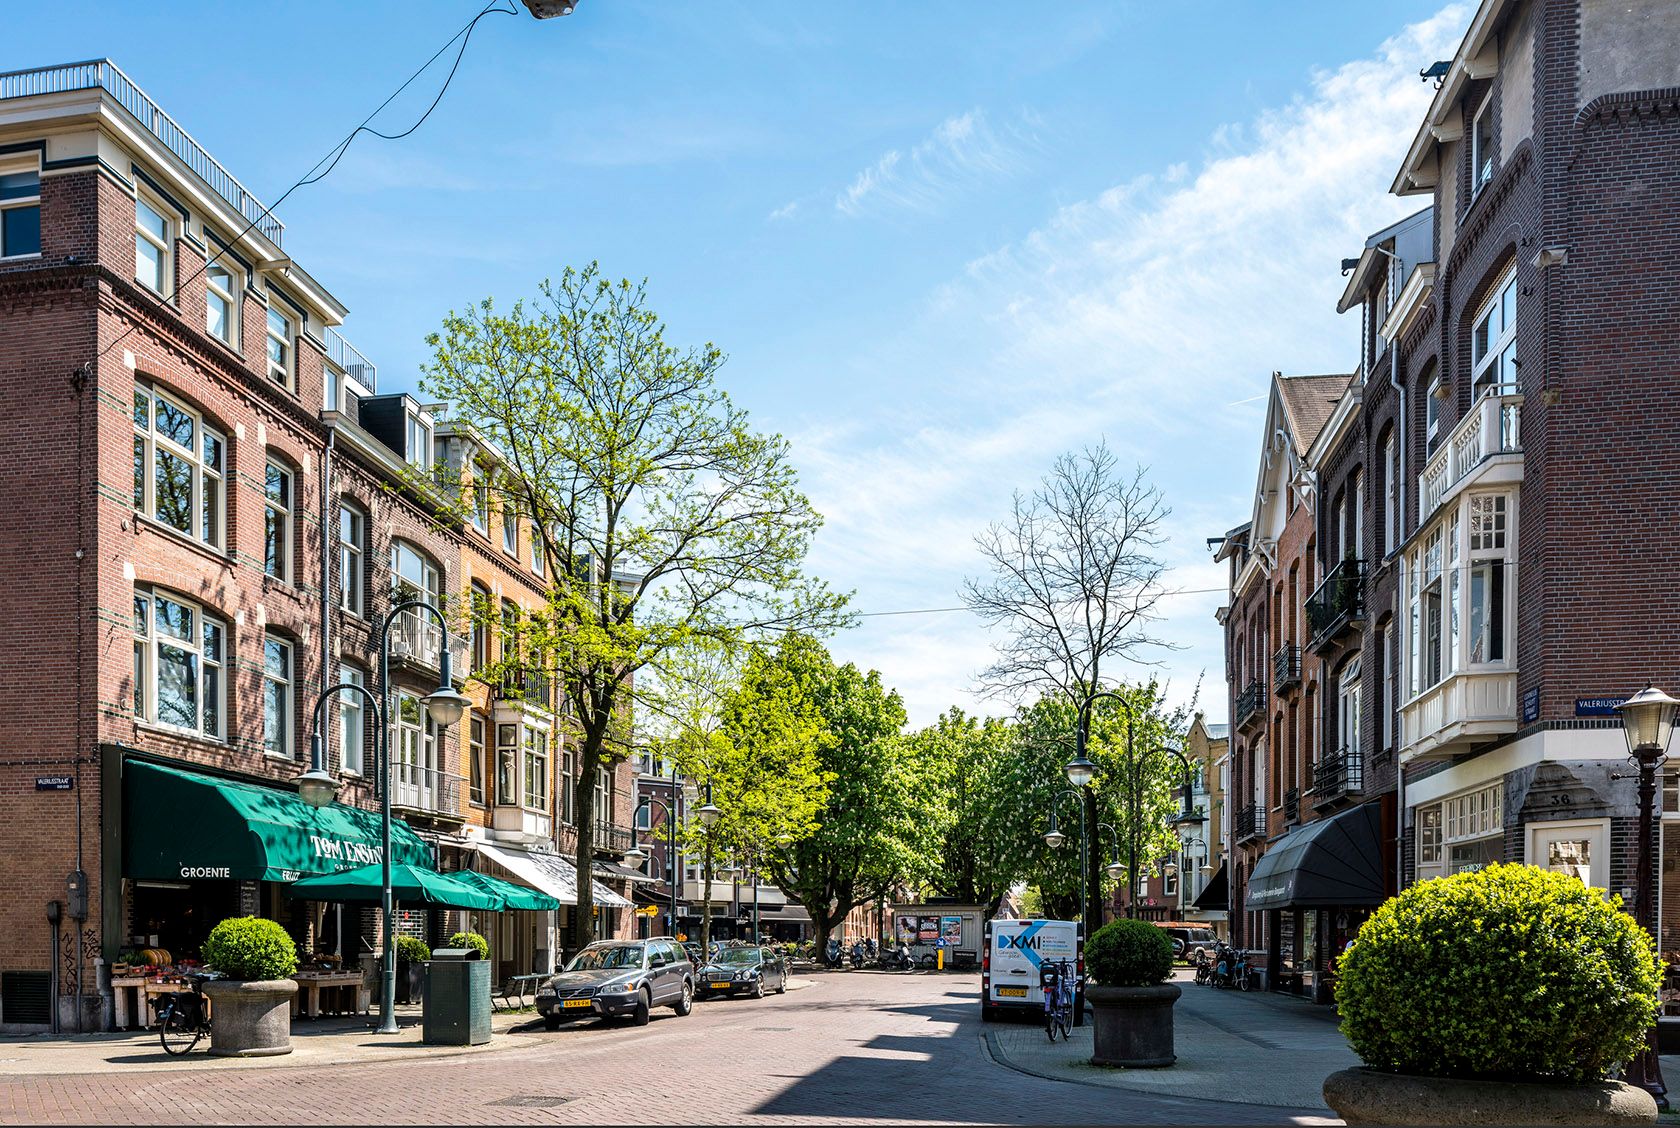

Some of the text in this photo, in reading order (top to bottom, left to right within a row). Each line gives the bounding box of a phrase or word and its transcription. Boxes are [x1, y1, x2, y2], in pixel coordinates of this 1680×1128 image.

[1579, 699, 1628, 708] VALERIUSSTR
[1551, 794, 1570, 805] 36
[180, 867, 230, 878] GROENTE
